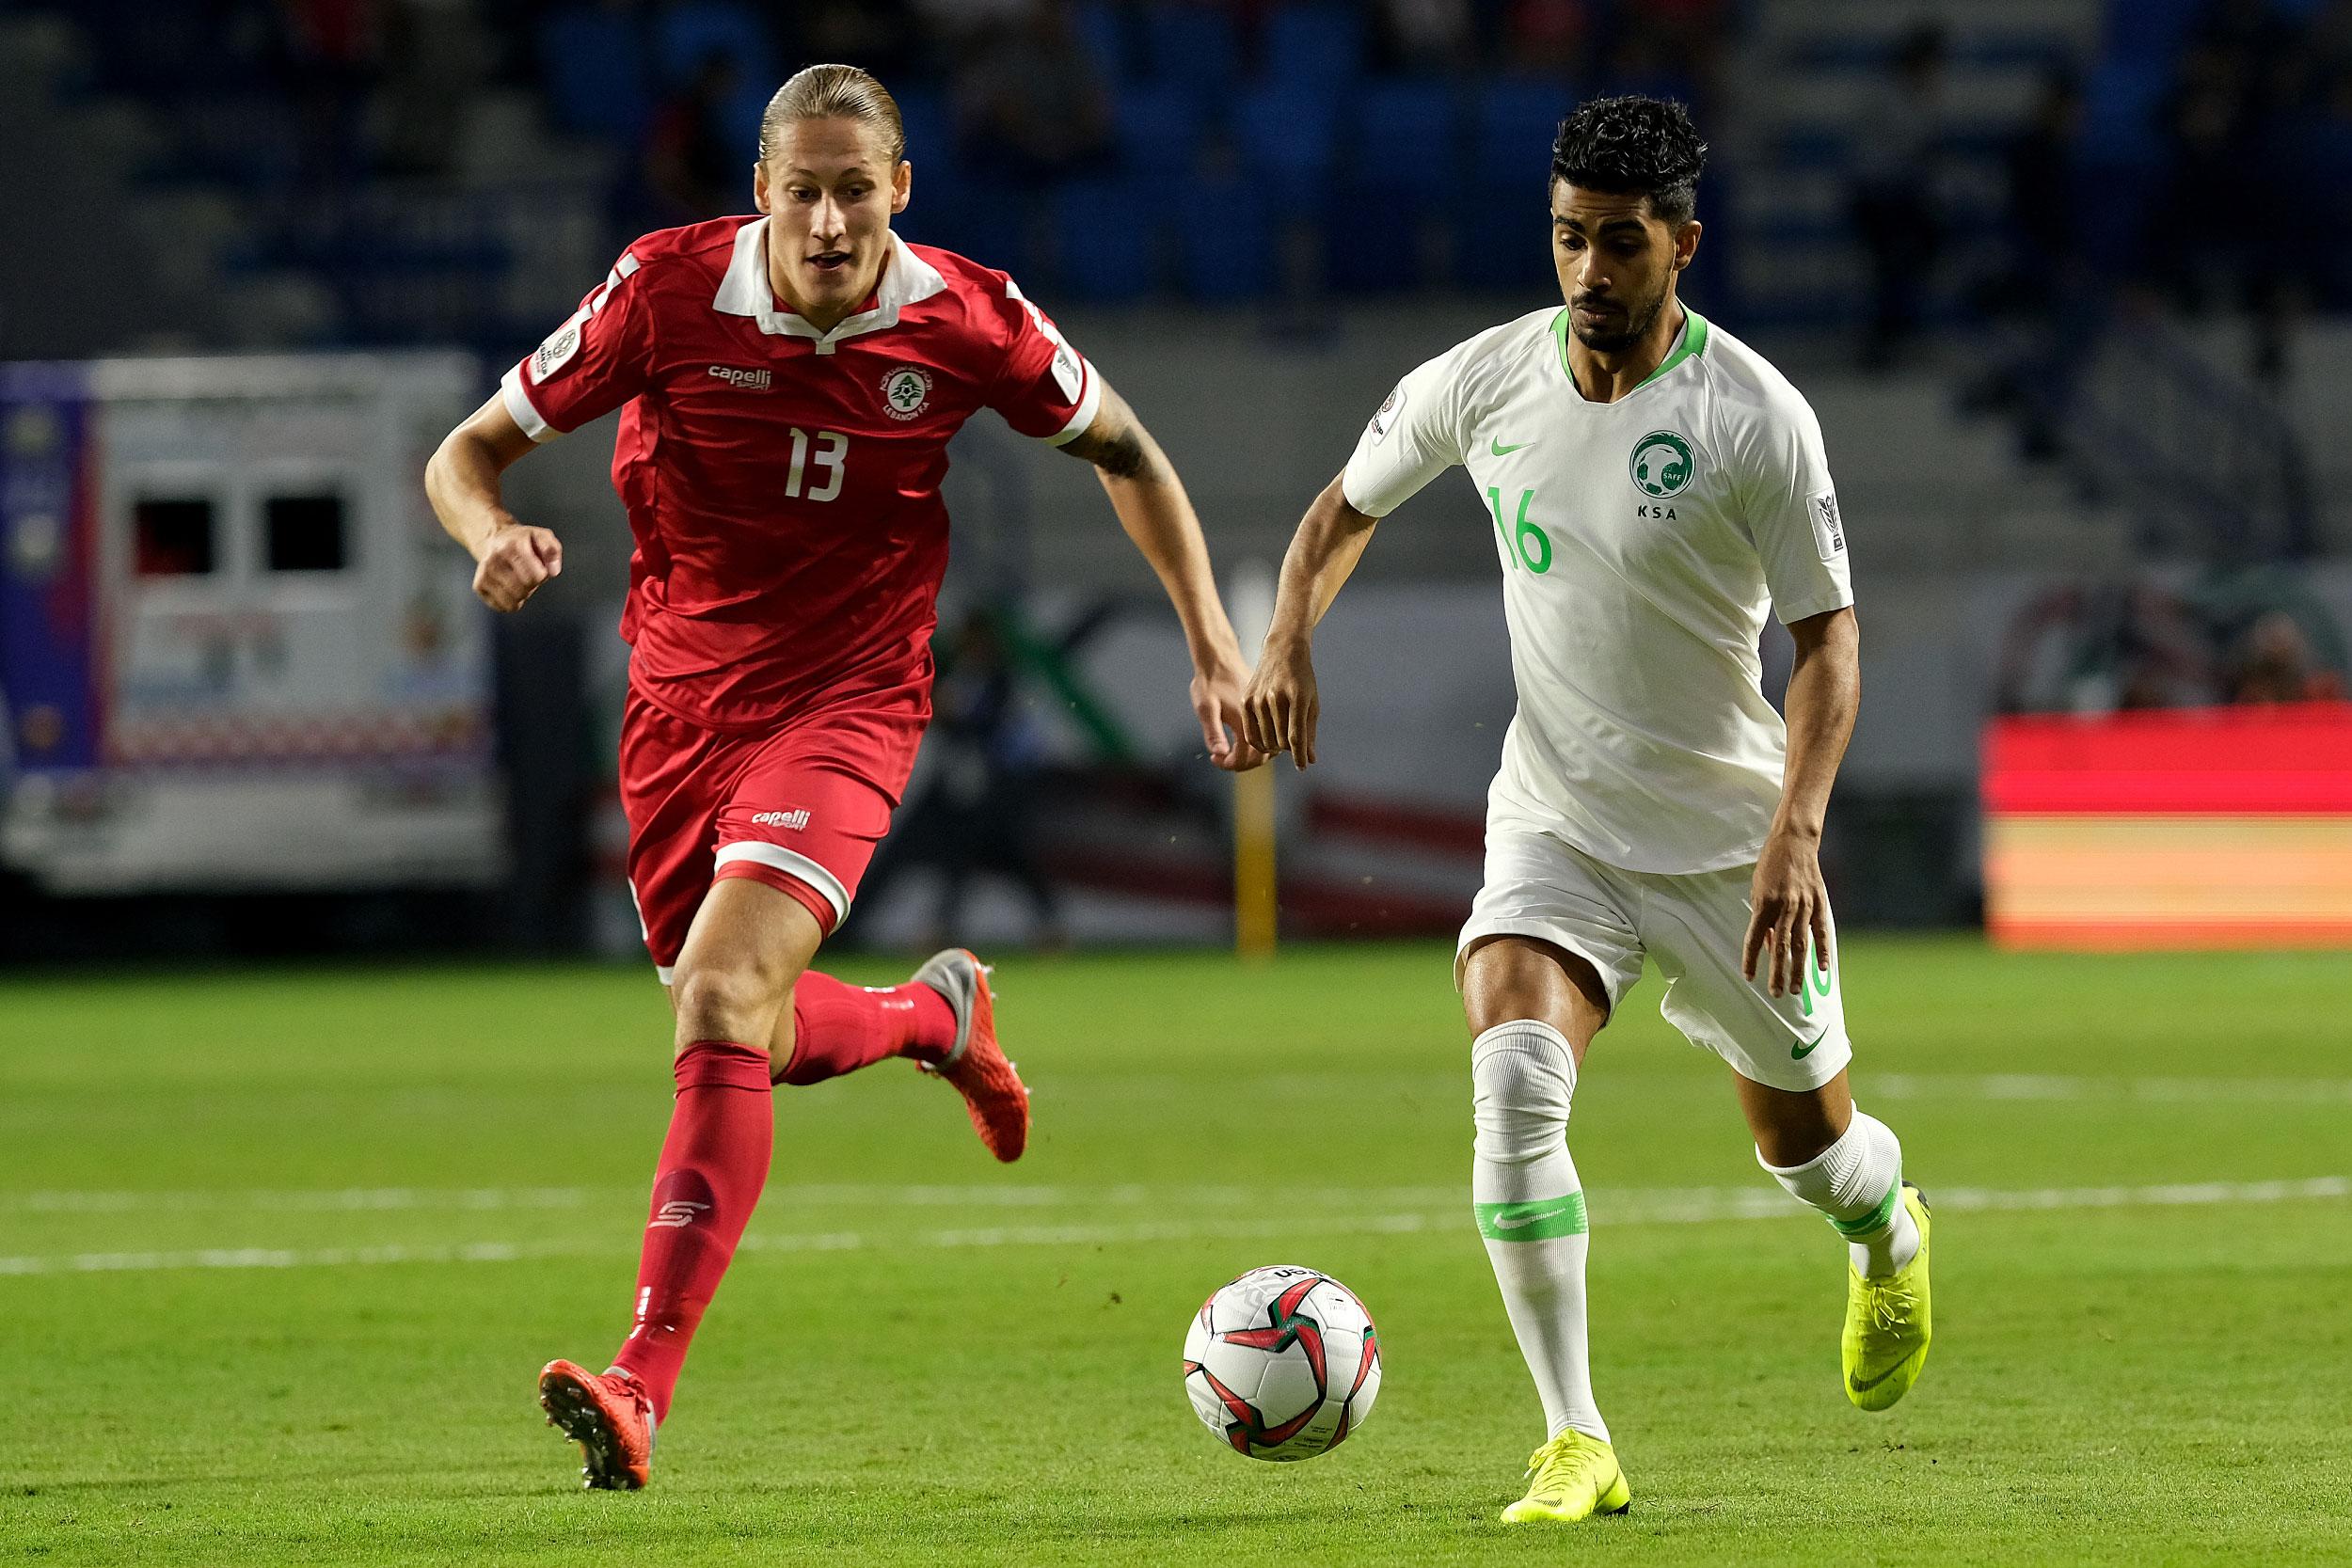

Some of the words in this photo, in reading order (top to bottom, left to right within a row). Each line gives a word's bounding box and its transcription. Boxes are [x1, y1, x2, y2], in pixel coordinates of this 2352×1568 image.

[707, 365, 771, 385] capelli
[882, 404, 919, 421] LEBANON
[785, 427, 849, 501] 13
[1662, 472, 1682, 481] SAFF
[1637, 505, 1677, 520] KSA
[1486, 486, 1552, 574] 16
[752, 809, 811, 826] capelli
